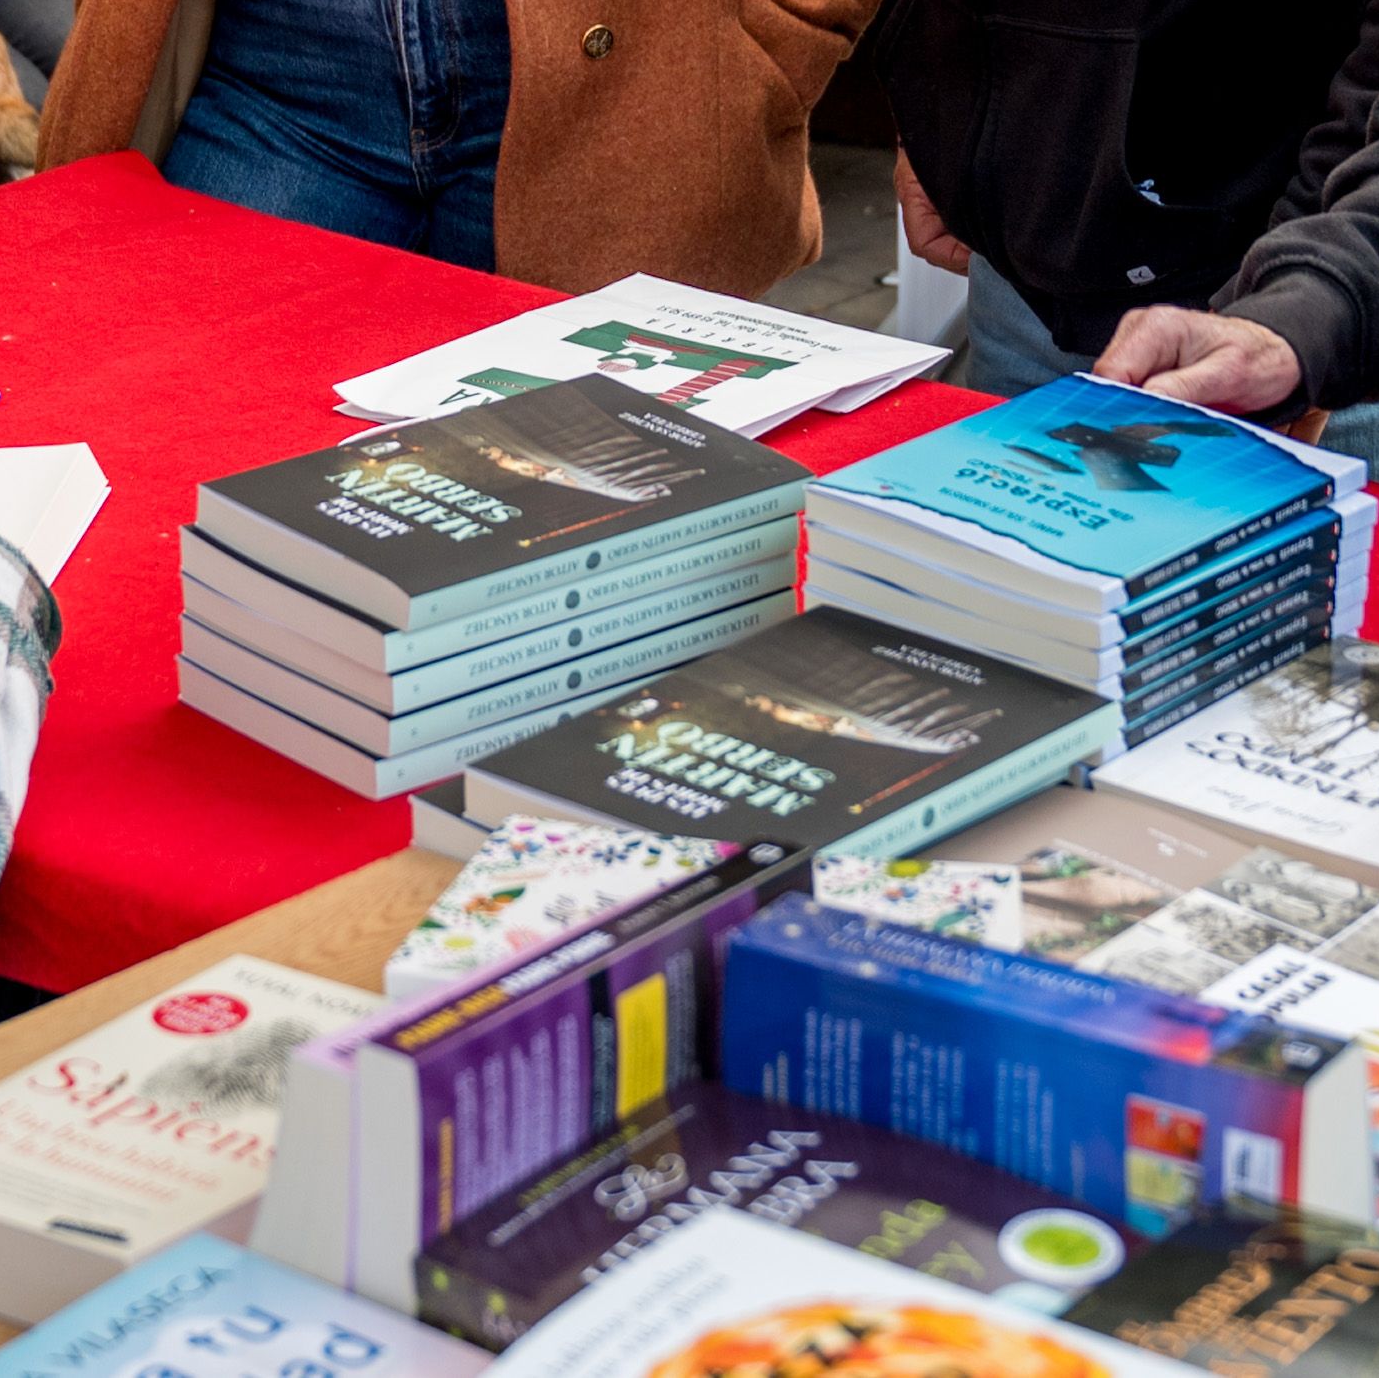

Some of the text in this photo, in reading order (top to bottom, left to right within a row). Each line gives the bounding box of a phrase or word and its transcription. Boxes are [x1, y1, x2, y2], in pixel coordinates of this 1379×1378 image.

[324, 468, 495, 543] MARTÍN
[544, 559, 577, 580] AITOR
[522, 599, 556, 619] AITOR
[525, 637, 560, 658] AITOR
[525, 678, 559, 699] AITOR
[595, 732, 817, 817] MARTÍN
[1236, 960, 1308, 1002] CASAL
[1264, 973, 1337, 1015] PULAR
[27, 1055, 277, 1170] Sapiens
